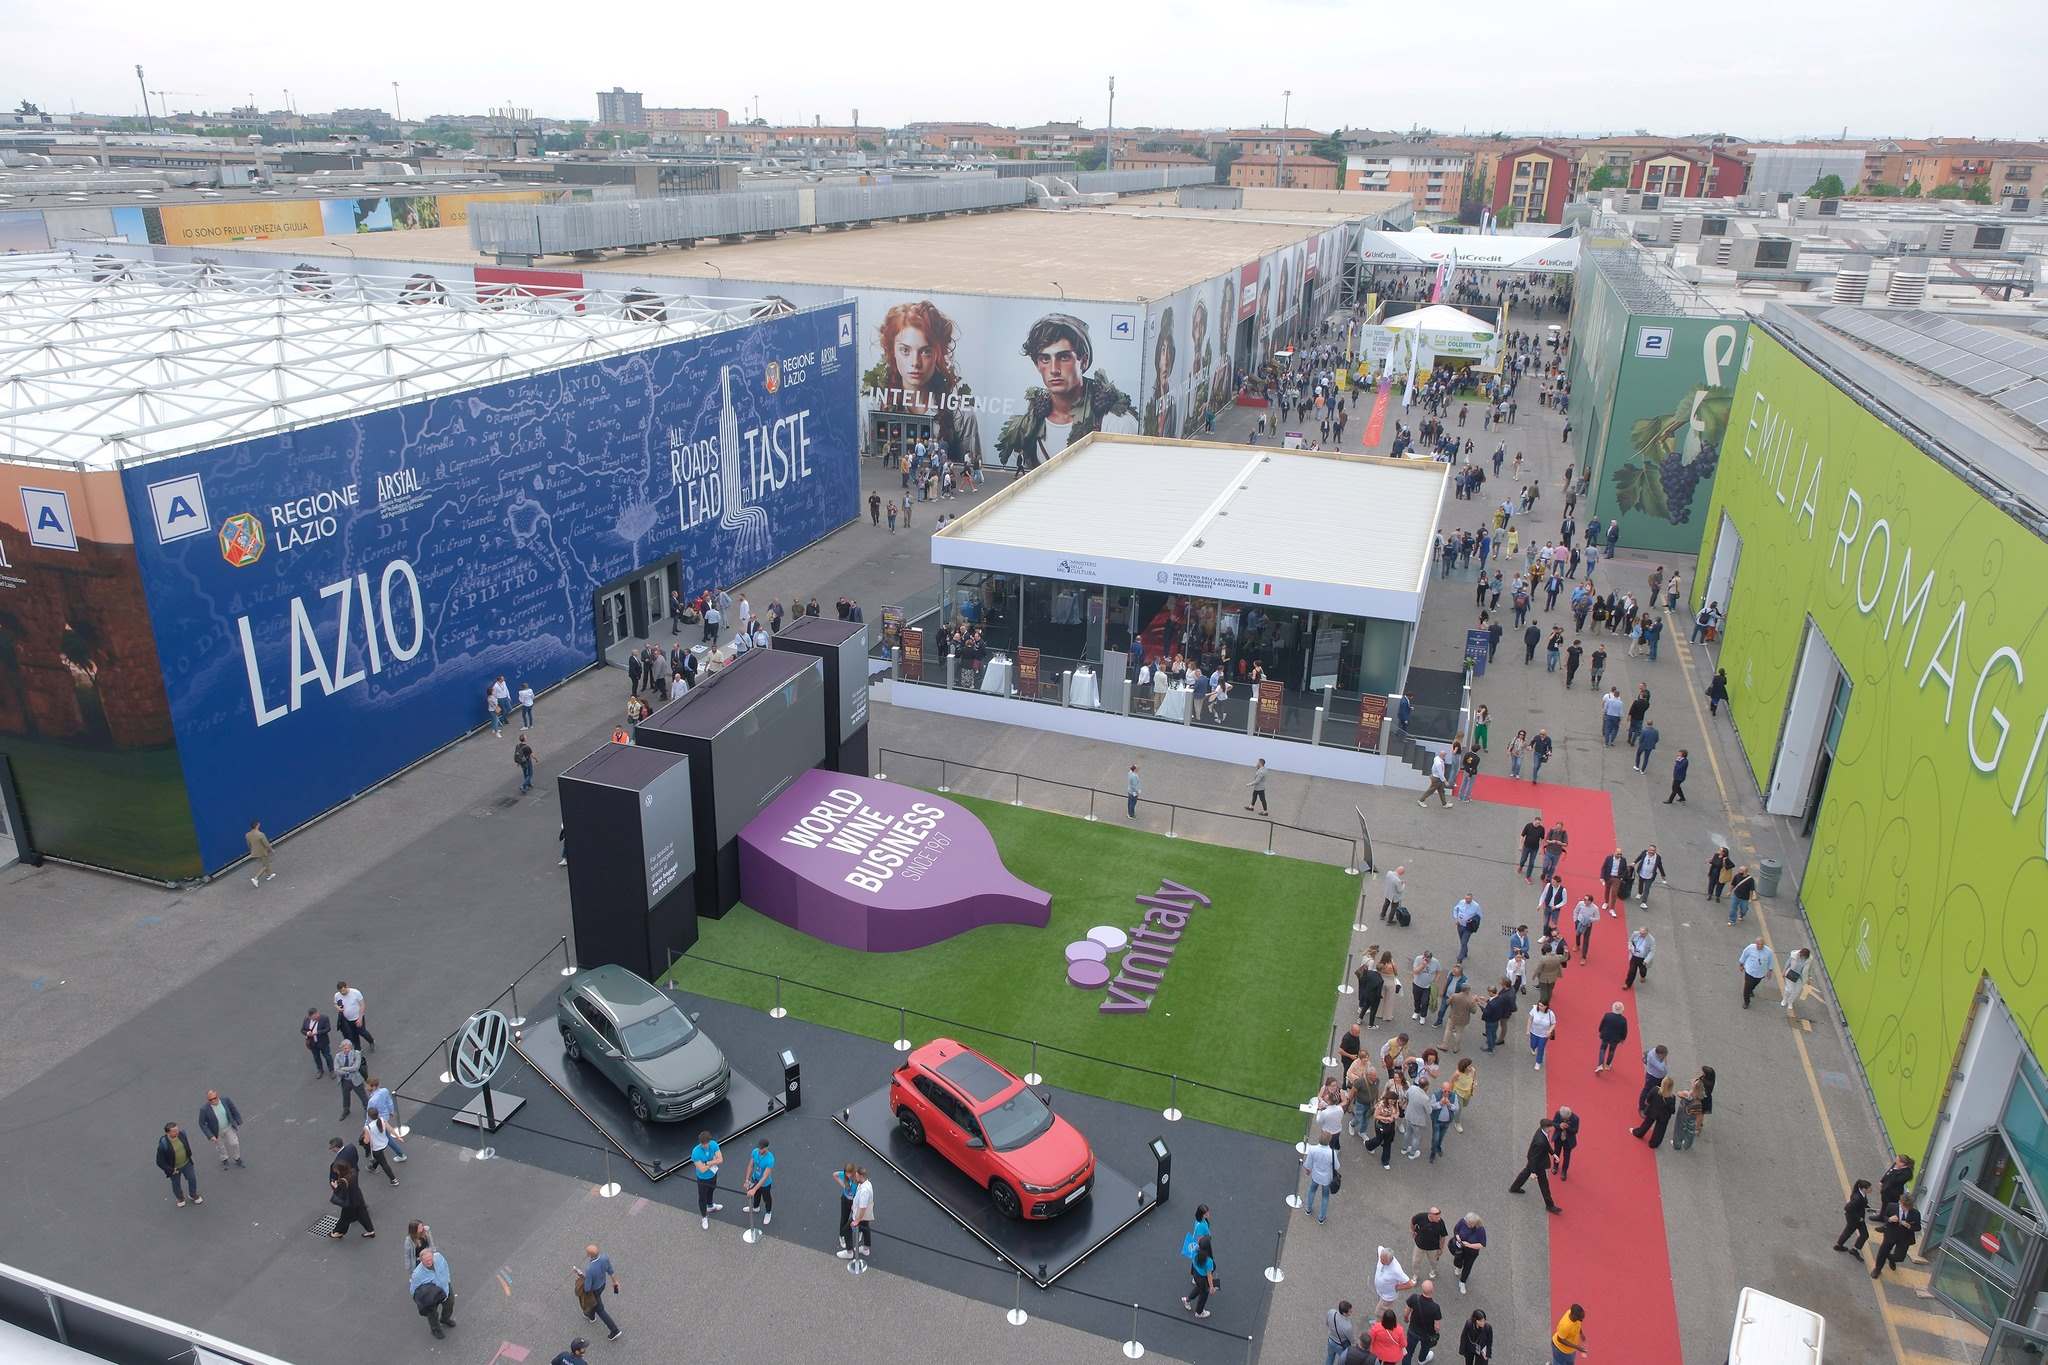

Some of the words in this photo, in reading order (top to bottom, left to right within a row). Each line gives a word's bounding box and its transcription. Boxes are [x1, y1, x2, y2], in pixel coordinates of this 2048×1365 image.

[182, 229, 193, 238] IO
[195, 228, 222, 238] SONO
[223, 226, 247, 235] FRIULI
[249, 224, 281, 233] VENEZIA
[283, 223, 309, 232] GIULIA
[1371, 251, 1397, 259] UniCredit
[1546, 258, 1574, 267] UniCredit
[842, 323, 849, 337] A
[1116, 322, 1129, 333] 4
[1646, 335, 1662, 349] 2
[1447, 341, 1481, 349] COLDIRETTI
[783, 352, 815, 371] REGIONE
[783, 370, 807, 388] LAZIO
[869, 387, 1015, 415] INTELLIGENCE
[670, 427, 683, 449] ALL
[671, 436, 719, 485] ROADS
[744, 409, 812, 500] TASTE
[1744, 391, 1822, 539] EMILIA
[378, 467, 422, 502] ARSIAL
[741, 487, 750, 504] TO
[168, 495, 197, 524] A
[271, 484, 360, 527] REGIONE
[678, 473, 722, 531] LEAD
[38, 506, 64, 532] A
[275, 516, 337, 552] LAZIO
[238, 559, 425, 727] LAZIO
[780, 788, 863, 849] WORLD
[825, 805, 895, 856] WINE
[844, 802, 945, 893] BUSINESS
[901, 850, 938, 882] SINCE
[925, 831, 952, 855] 1967
[1099, 878, 1212, 1015] vinitaly
